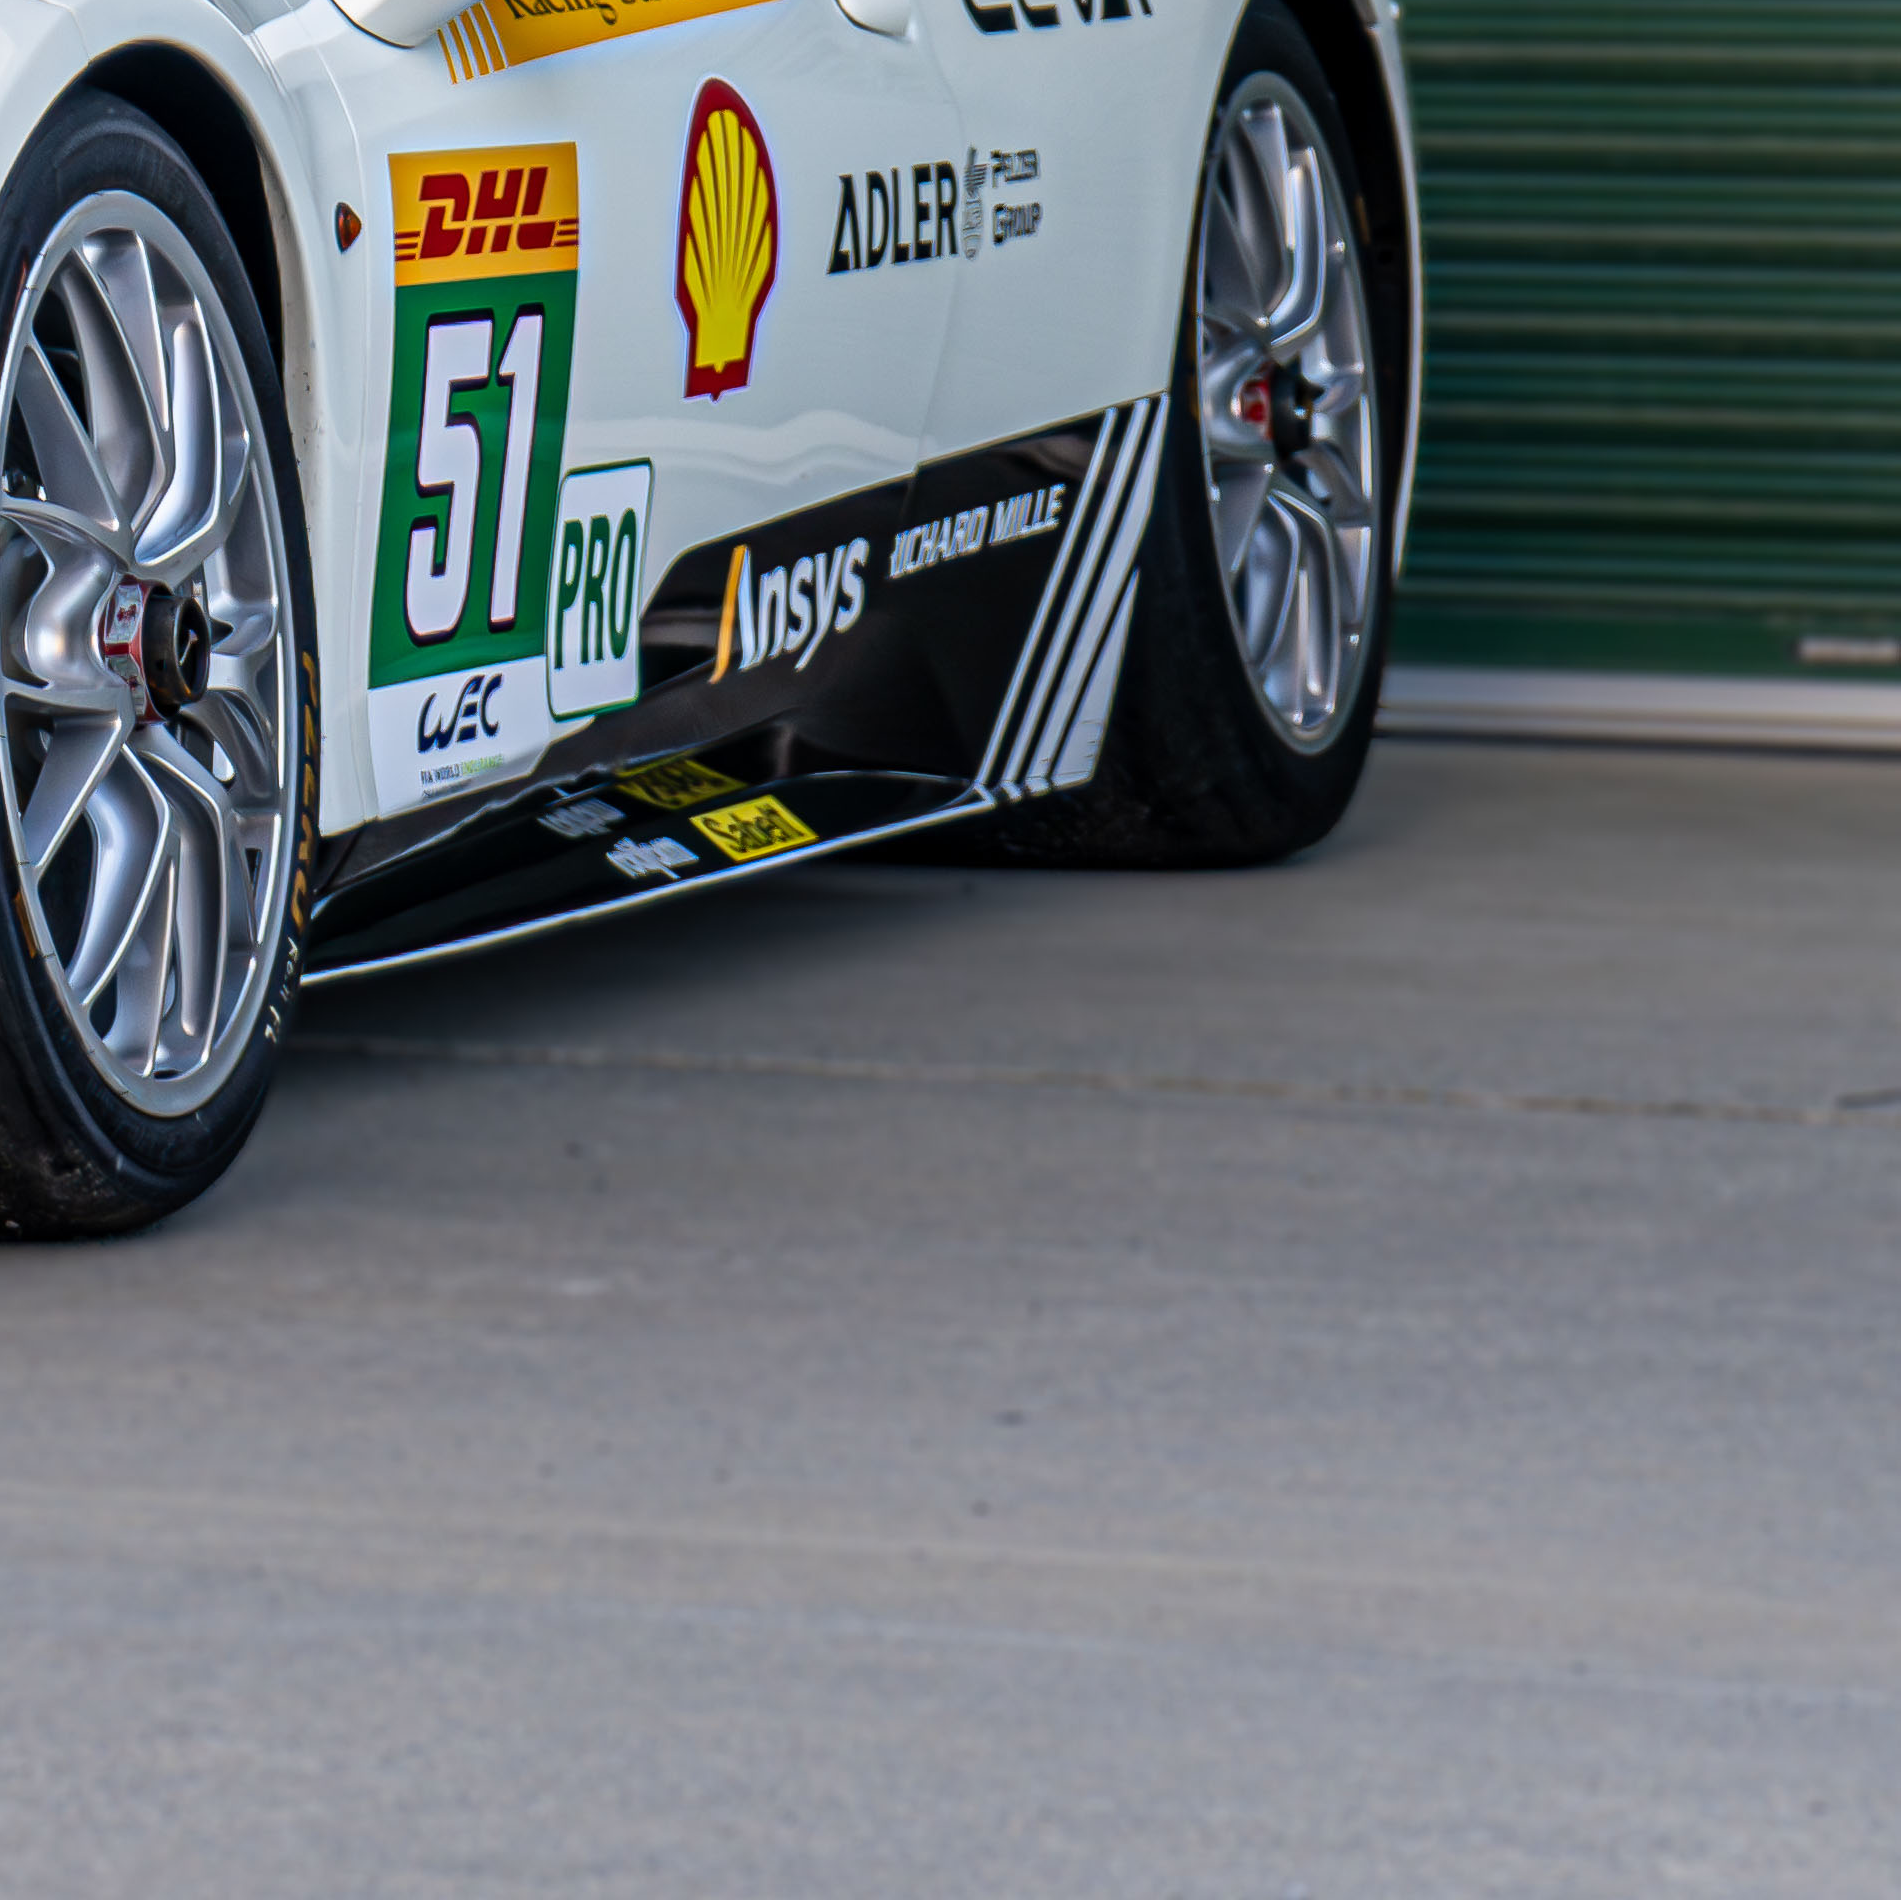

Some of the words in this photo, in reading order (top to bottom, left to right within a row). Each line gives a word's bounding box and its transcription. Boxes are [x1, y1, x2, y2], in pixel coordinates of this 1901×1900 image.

[419, 166, 557, 259] DHL
[826, 160, 958, 274] ADLER
[404, 303, 546, 647] 51
[989, 483, 1066, 546] MILLE
[554, 506, 638, 672] PRO
[709, 536, 870, 684] Ansys
[417, 672, 503, 754] WEC
